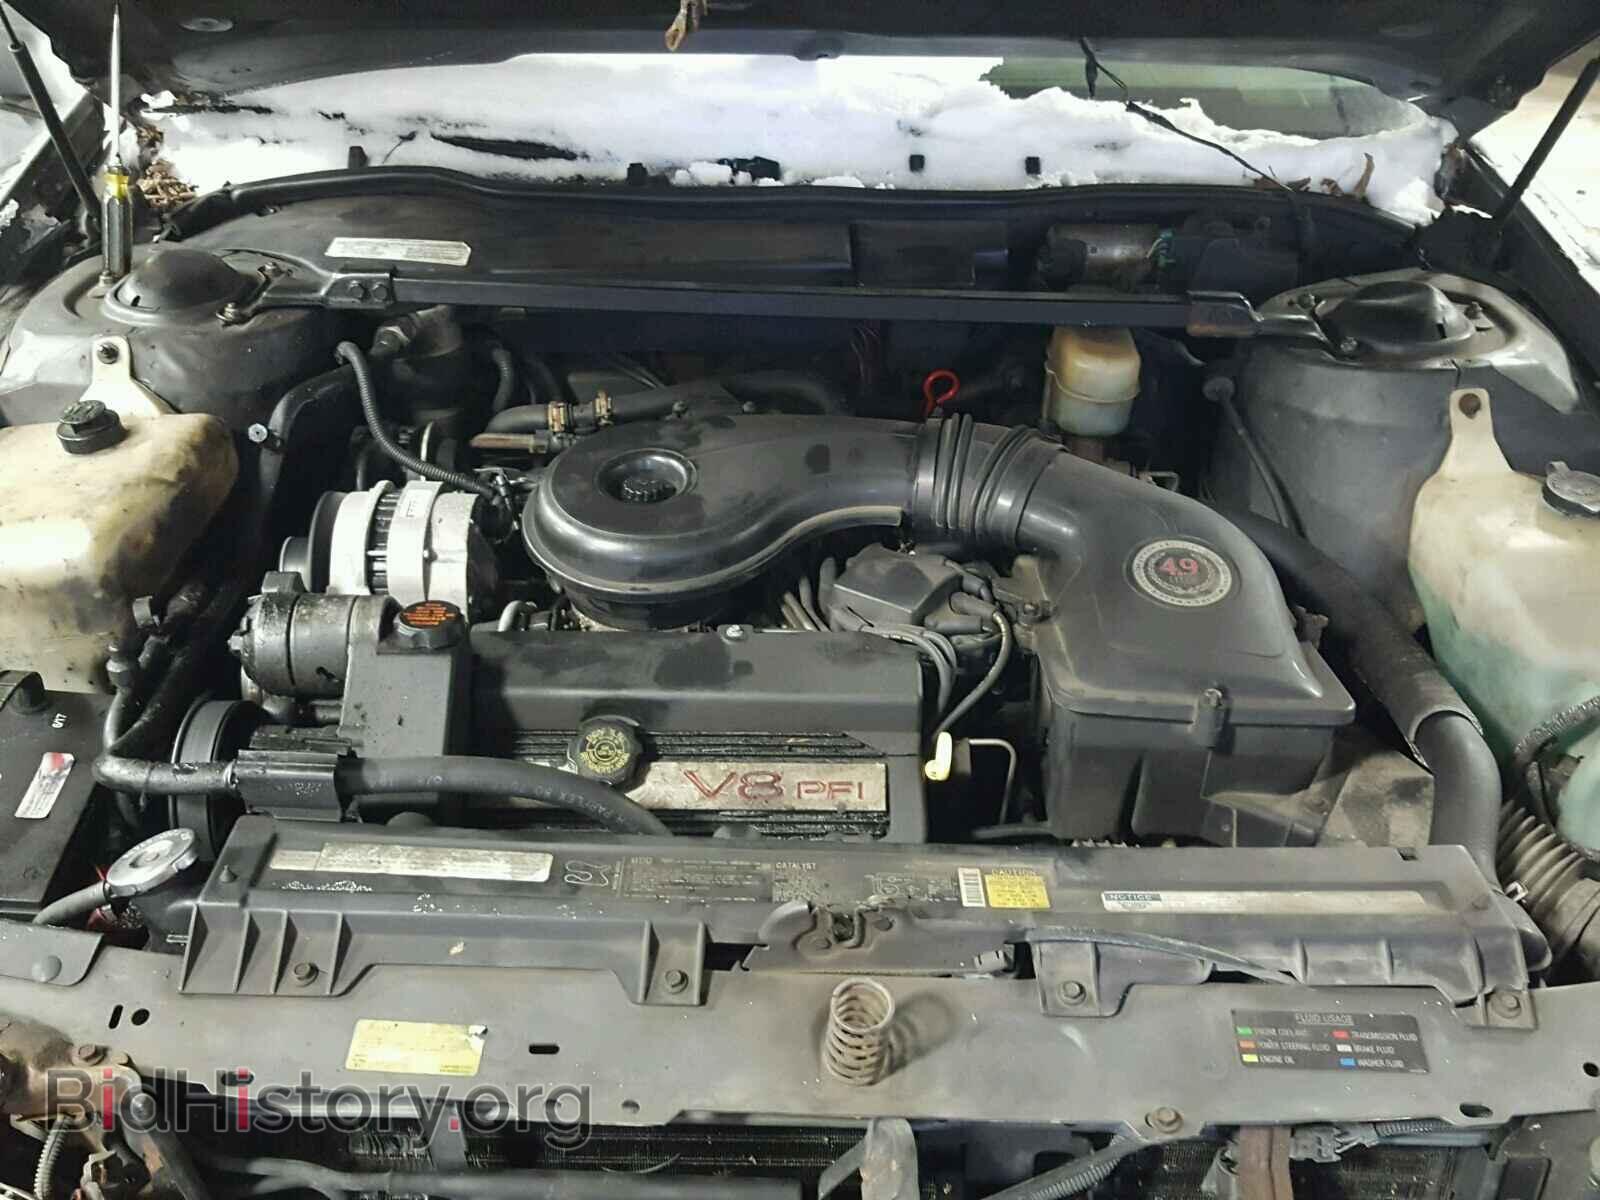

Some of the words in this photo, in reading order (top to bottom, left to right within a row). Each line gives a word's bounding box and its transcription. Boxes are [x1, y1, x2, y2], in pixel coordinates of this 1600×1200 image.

[683, 769, 784, 800] V8
[796, 780, 863, 800] PFI
[1109, 892, 1152, 901] NOTICE
[1295, 1012, 1321, 1024] FLUID
[1322, 1013, 1354, 1025] USAGE
